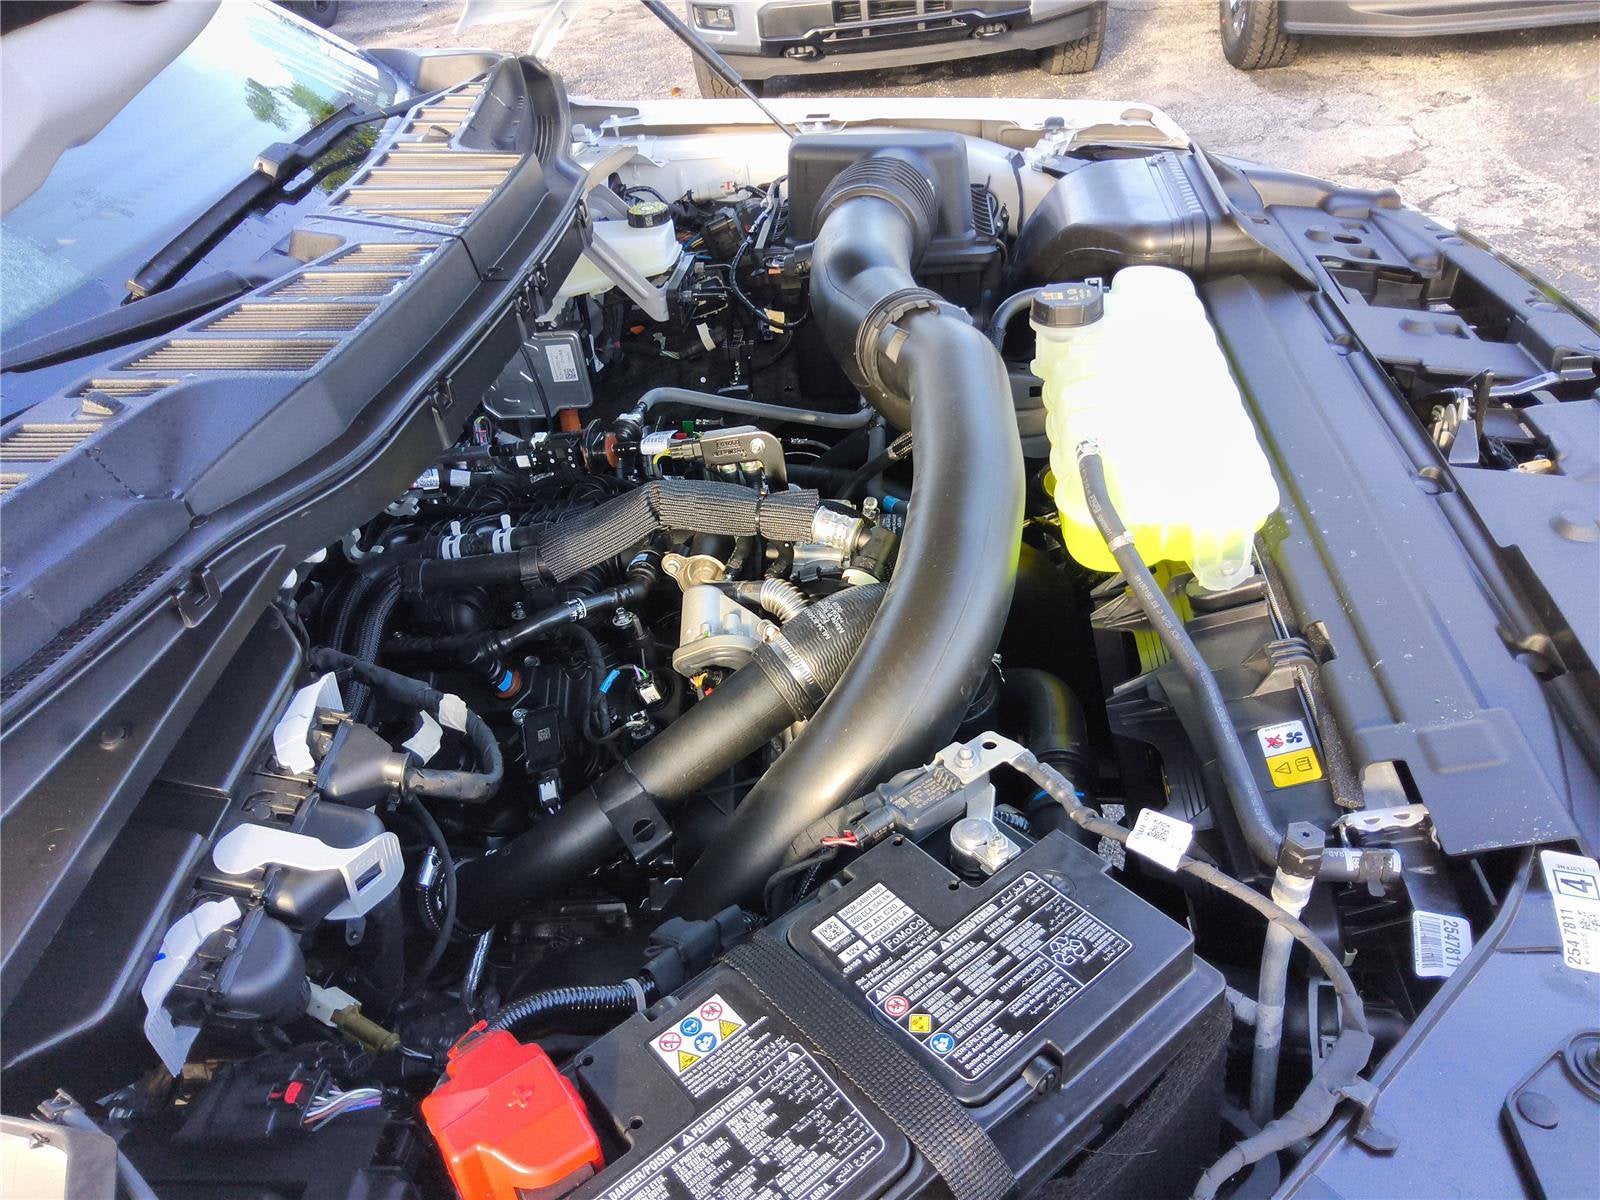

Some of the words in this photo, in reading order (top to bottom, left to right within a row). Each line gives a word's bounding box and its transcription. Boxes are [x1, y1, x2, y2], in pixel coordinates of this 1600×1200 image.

[1561, 878, 1592, 893] 4
[868, 910, 909, 940] AGM/VRLA
[871, 914, 884, 923] Ah
[882, 903, 898, 915] C20
[945, 902, 999, 943] PELIGRO/VENENO
[1561, 908, 1576, 936] 7811
[884, 917, 925, 948] FoMoCo
[1443, 920, 1461, 968] 2547811
[845, 944, 861, 957] 12V
[862, 944, 884, 962] MF
[1568, 940, 1582, 966] 254
[880, 949, 938, 993] DANGER/POISON
[1007, 993, 1031, 1012] CONTRA
[1028, 970, 1059, 995] DERRAMES
[951, 1022, 996, 1058] NON-SPILLABLE
[957, 1050, 973, 1063] Lead
[970, 1040, 985, 1052] Acid
[982, 1026, 1004, 1044] Battery
[964, 1050, 987, 1069] Batterie
[984, 1045, 994, 1053] au
[990, 1032, 1010, 1048] plomb
[970, 1061, 987, 1075] ANTI
[982, 1029, 1024, 1064] DÉVERSEMENT
[680, 1071, 693, 1082] Made
[696, 1060, 707, 1070] USA
[689, 1084, 754, 1138] PELIGRO/VENENO
[725, 1106, 750, 1128] PROTEJA
[747, 1099, 760, 1111] LOS
[734, 1111, 767, 1139] EXPLOSIVOS
[744, 1110, 757, 1122] LOS
[754, 1097, 773, 1114] GASES
[739, 1126, 760, 1145] PUEDEN
[757, 1112, 779, 1130] CAUSAR
[749, 1133, 775, 1155] CEGUERA.
[670, 1161, 682, 1172] SE
[677, 1140, 708, 1166] PROTÉGER
[770, 1135, 792, 1154] CHISPAS
[775, 1142, 796, 1160] FLAMAS
[780, 1143, 805, 1165] CIGARROS
[608, 1145, 677, 1200] DANGER/POISON
[675, 1165, 690, 1178] LES
[701, 1145, 714, 1157] LES
[680, 1157, 711, 1183] EXPLOSIFS
[708, 1141, 732, 1162] PEUVENT
[685, 1170, 707, 1189] CAUSER
[704, 1162, 716, 1174] DES
[689, 1169, 719, 1195] BLESSURES
[716, 1164, 726, 1173] ET
[723, 1159, 733, 1168] LA
[774, 1169, 794, 1187] ÁCIDO
[788, 1148, 819, 1175] SULFÚRICO
[781, 1178, 798, 1193] PUEDE
[794, 1165, 814, 1183] CAUSAR
[810, 1150, 832, 1170] CEGUERA
[719, 1186, 731, 1196] LES
[727, 1164, 756, 1189] ÉTINCELLES
[732, 1173, 757, 1195] FLAMMES
[790, 1170, 822, 1197] QUEMADURAS
